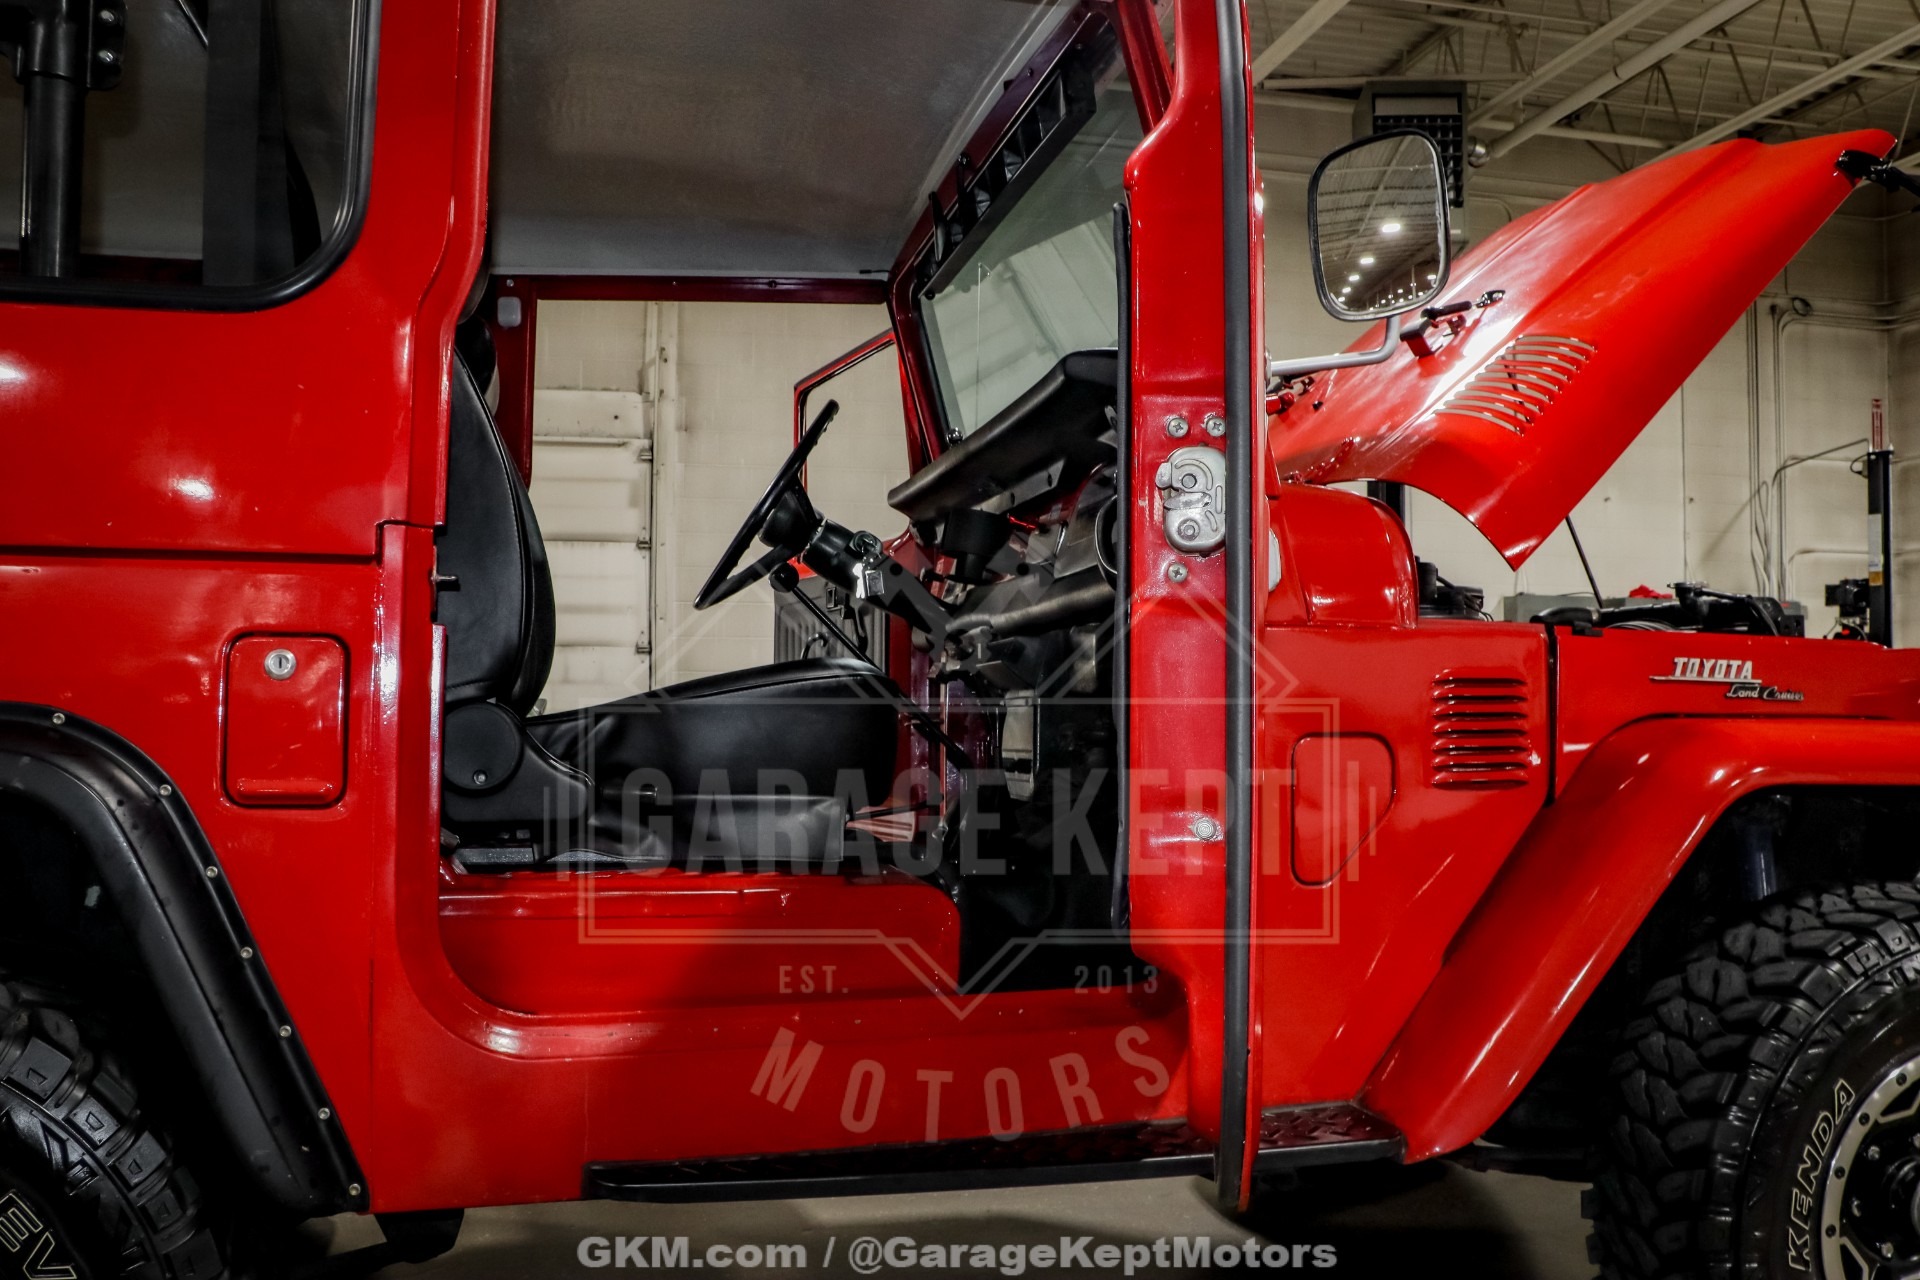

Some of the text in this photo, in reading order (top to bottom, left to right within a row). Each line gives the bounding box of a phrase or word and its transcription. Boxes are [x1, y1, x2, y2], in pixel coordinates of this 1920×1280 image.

[1674, 657, 1753, 680] TOYOTA
[1726, 684, 1760, 699] Land
[1788, 1079, 1856, 1272] KENDA
